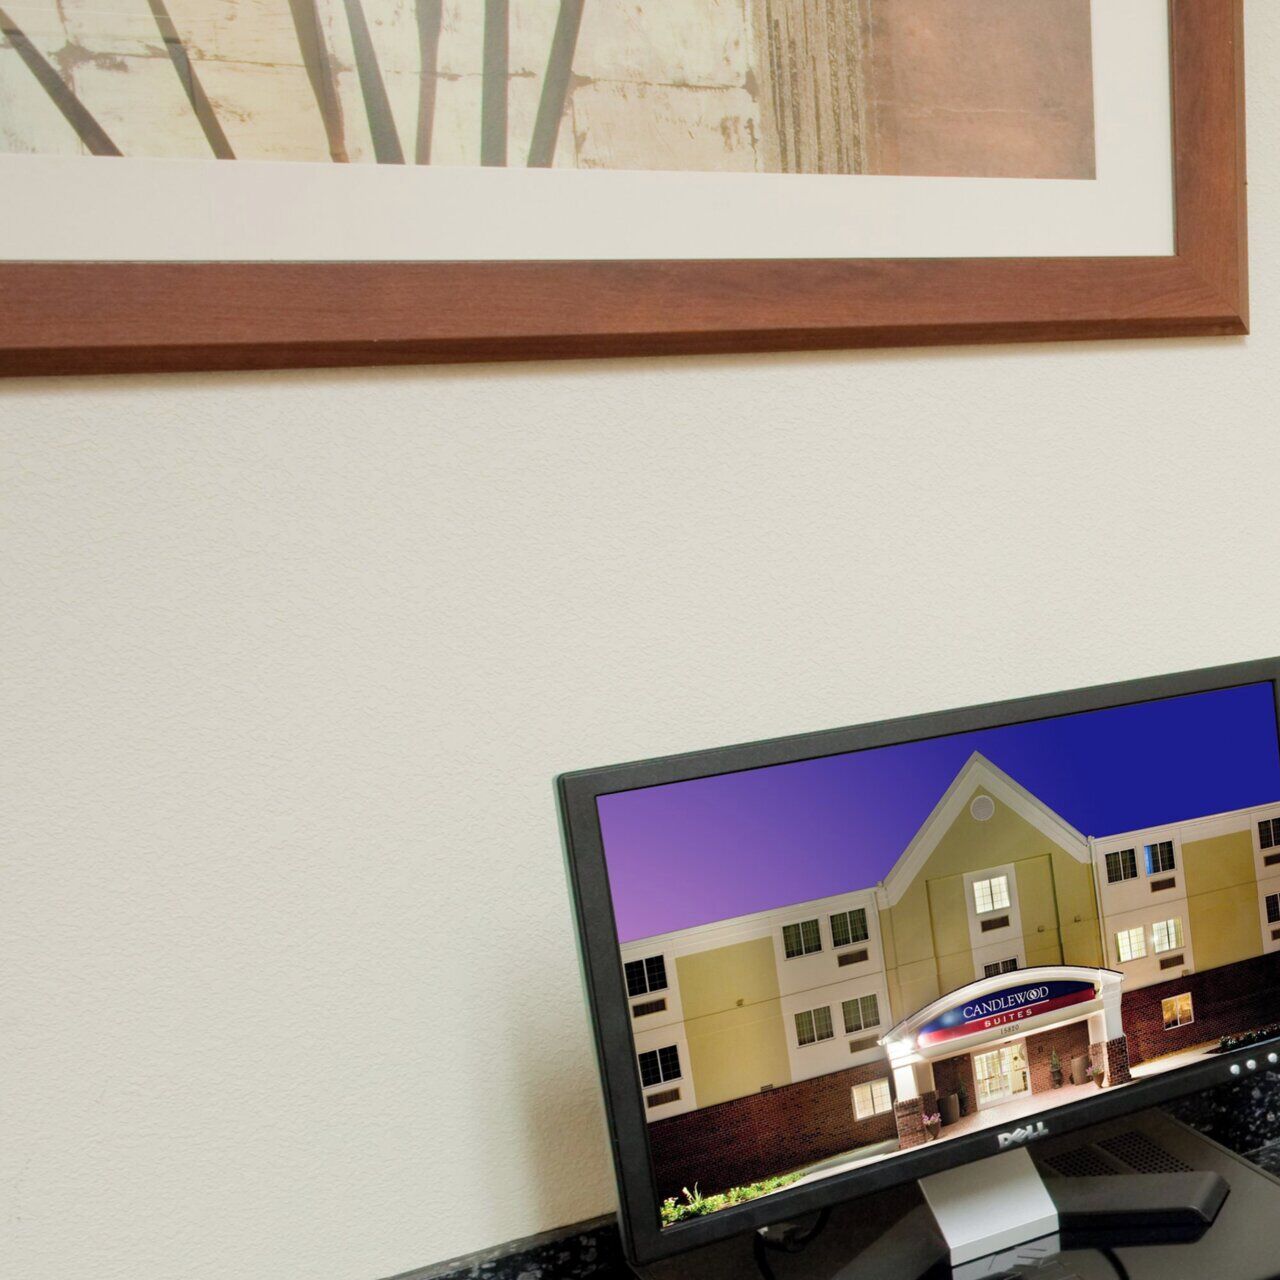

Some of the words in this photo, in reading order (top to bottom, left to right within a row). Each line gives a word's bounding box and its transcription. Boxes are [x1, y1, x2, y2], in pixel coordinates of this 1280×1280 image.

[963, 986, 1049, 1019] CANDLEWOOD
[984, 1008, 1033, 1027] SUITES
[1000, 1024, 1020, 1035] 15820
[997, 1121, 1049, 1147] DELL
